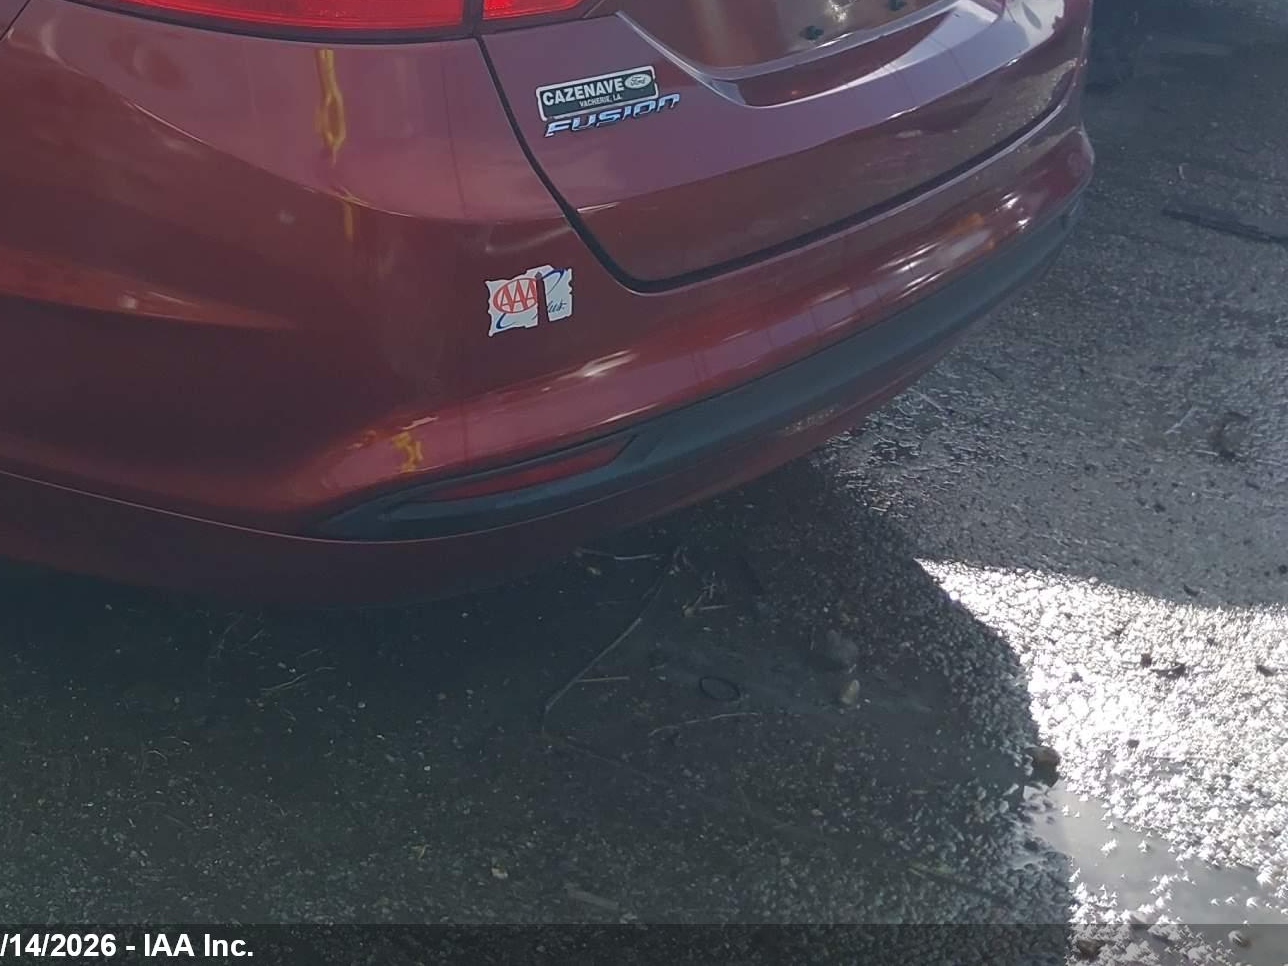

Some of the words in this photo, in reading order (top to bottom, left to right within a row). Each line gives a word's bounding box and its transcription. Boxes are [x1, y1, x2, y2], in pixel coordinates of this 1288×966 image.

[542, 78, 625, 106] CAZENAVE
[545, 94, 681, 138] FUSION
[497, 278, 538, 312] AAA
